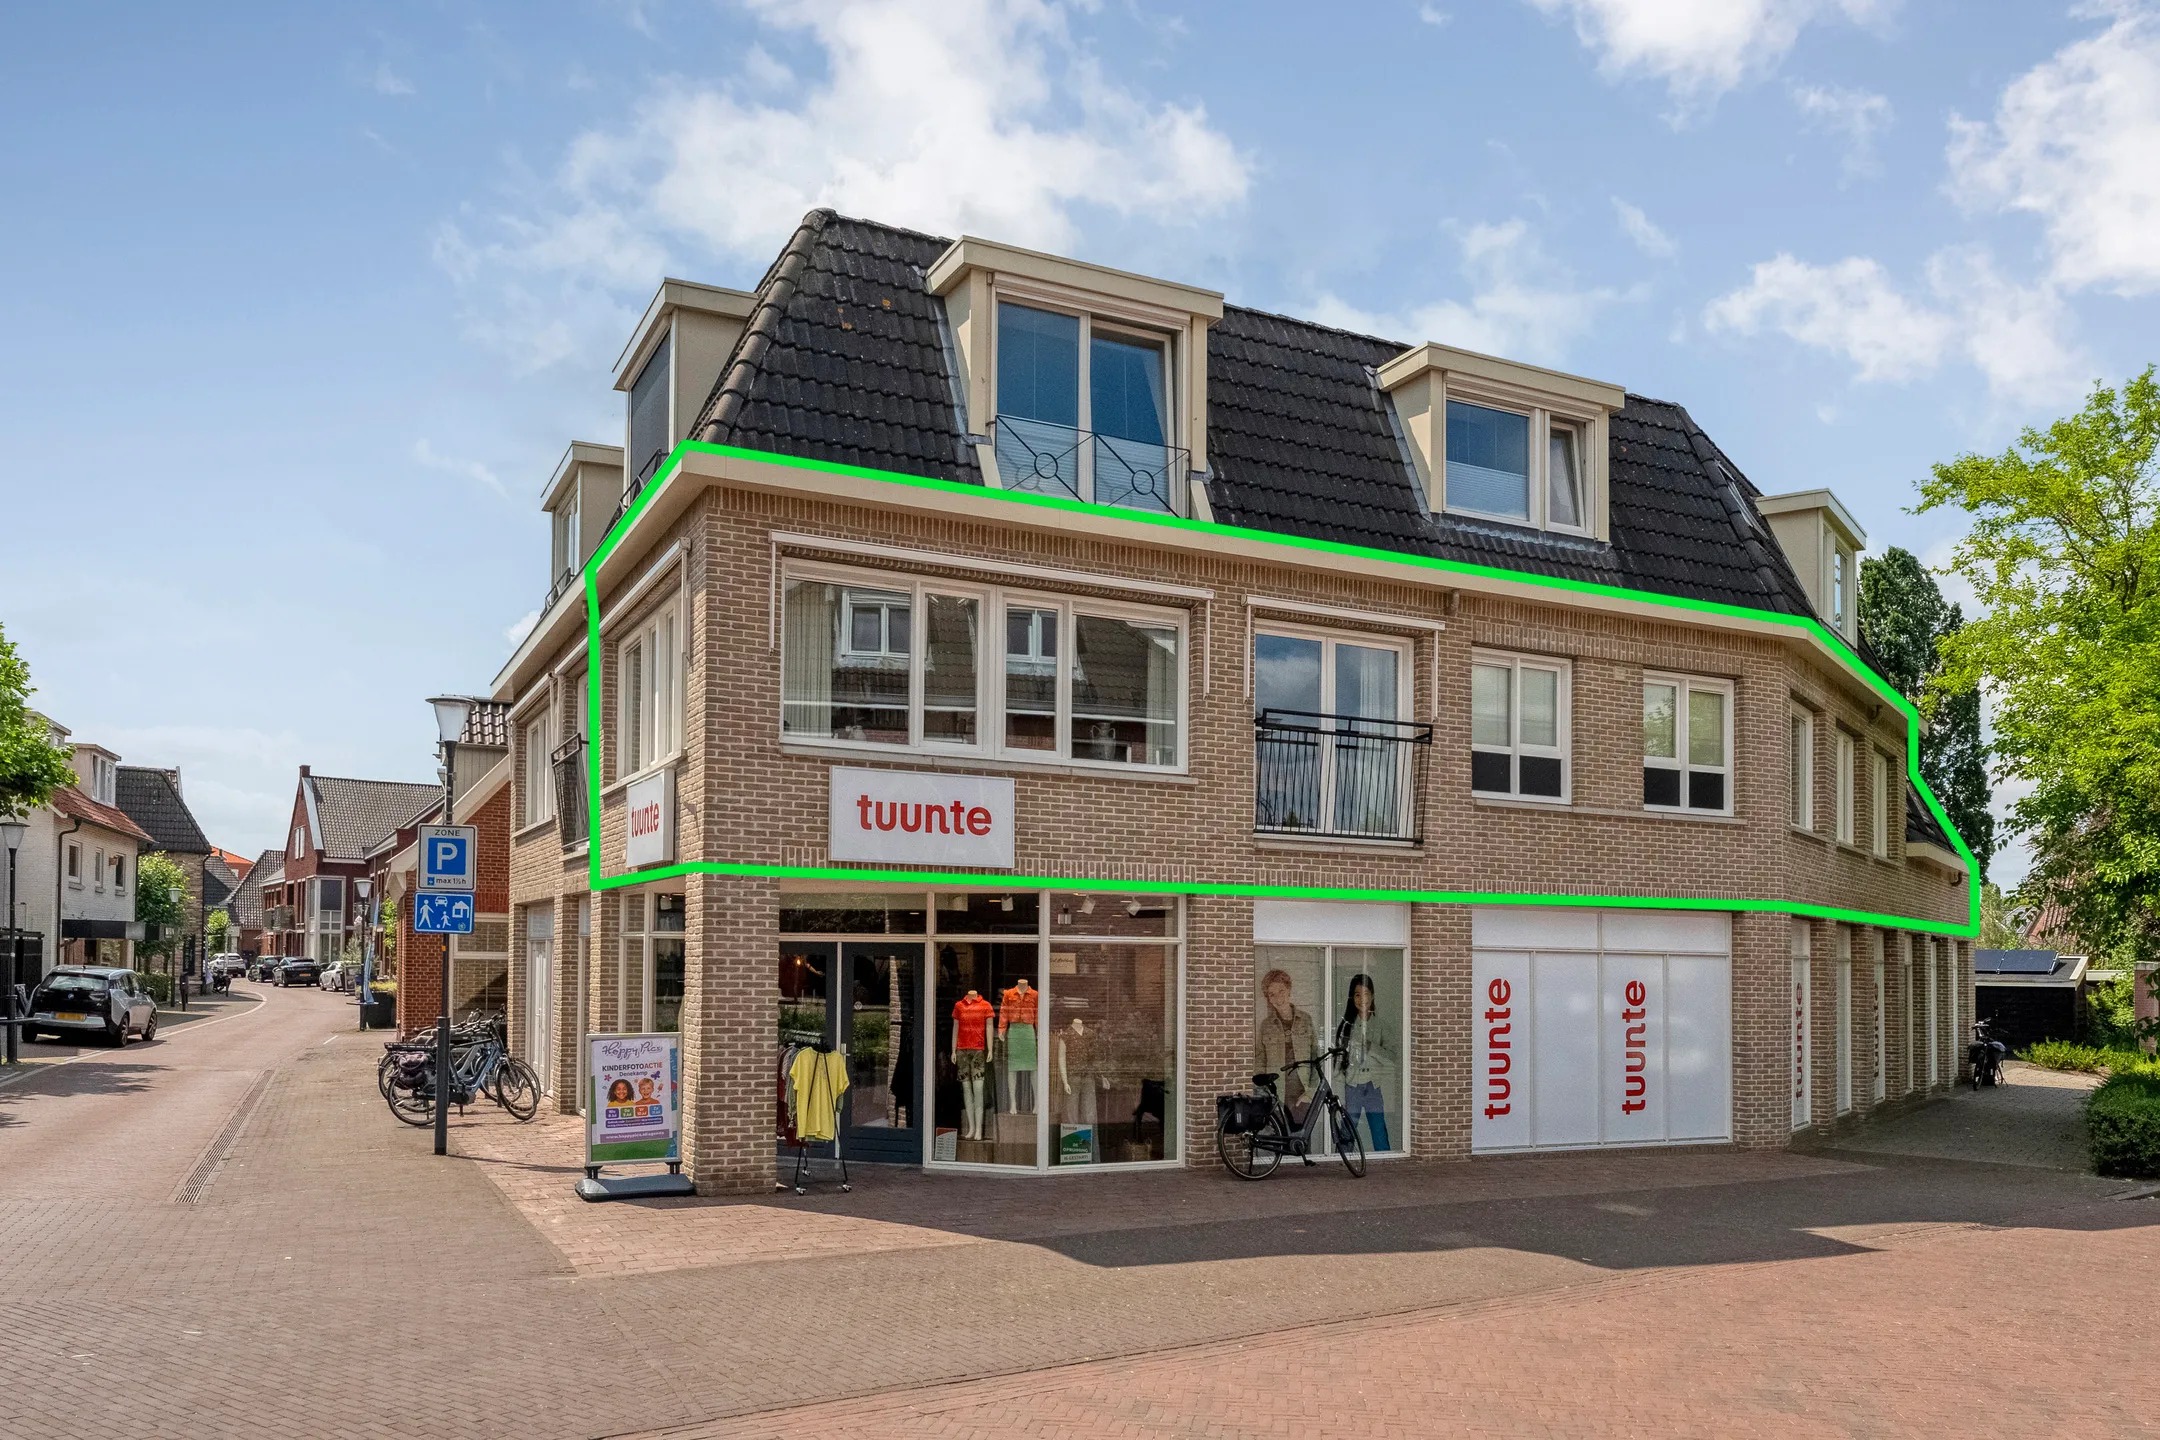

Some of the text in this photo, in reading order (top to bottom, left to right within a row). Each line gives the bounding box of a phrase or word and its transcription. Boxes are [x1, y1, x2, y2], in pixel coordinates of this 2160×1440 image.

[631, 800, 660, 837] tuunte
[856, 794, 992, 836] tuunte
[435, 829, 460, 837] ZONE
[436, 842, 458, 870] P
[602, 1041, 640, 1060] Happy
[1484, 978, 1511, 1120] tuunte
[1622, 980, 1646, 1115] tuunte
[602, 1062, 663, 1071] KINDERFOTOACTIE
